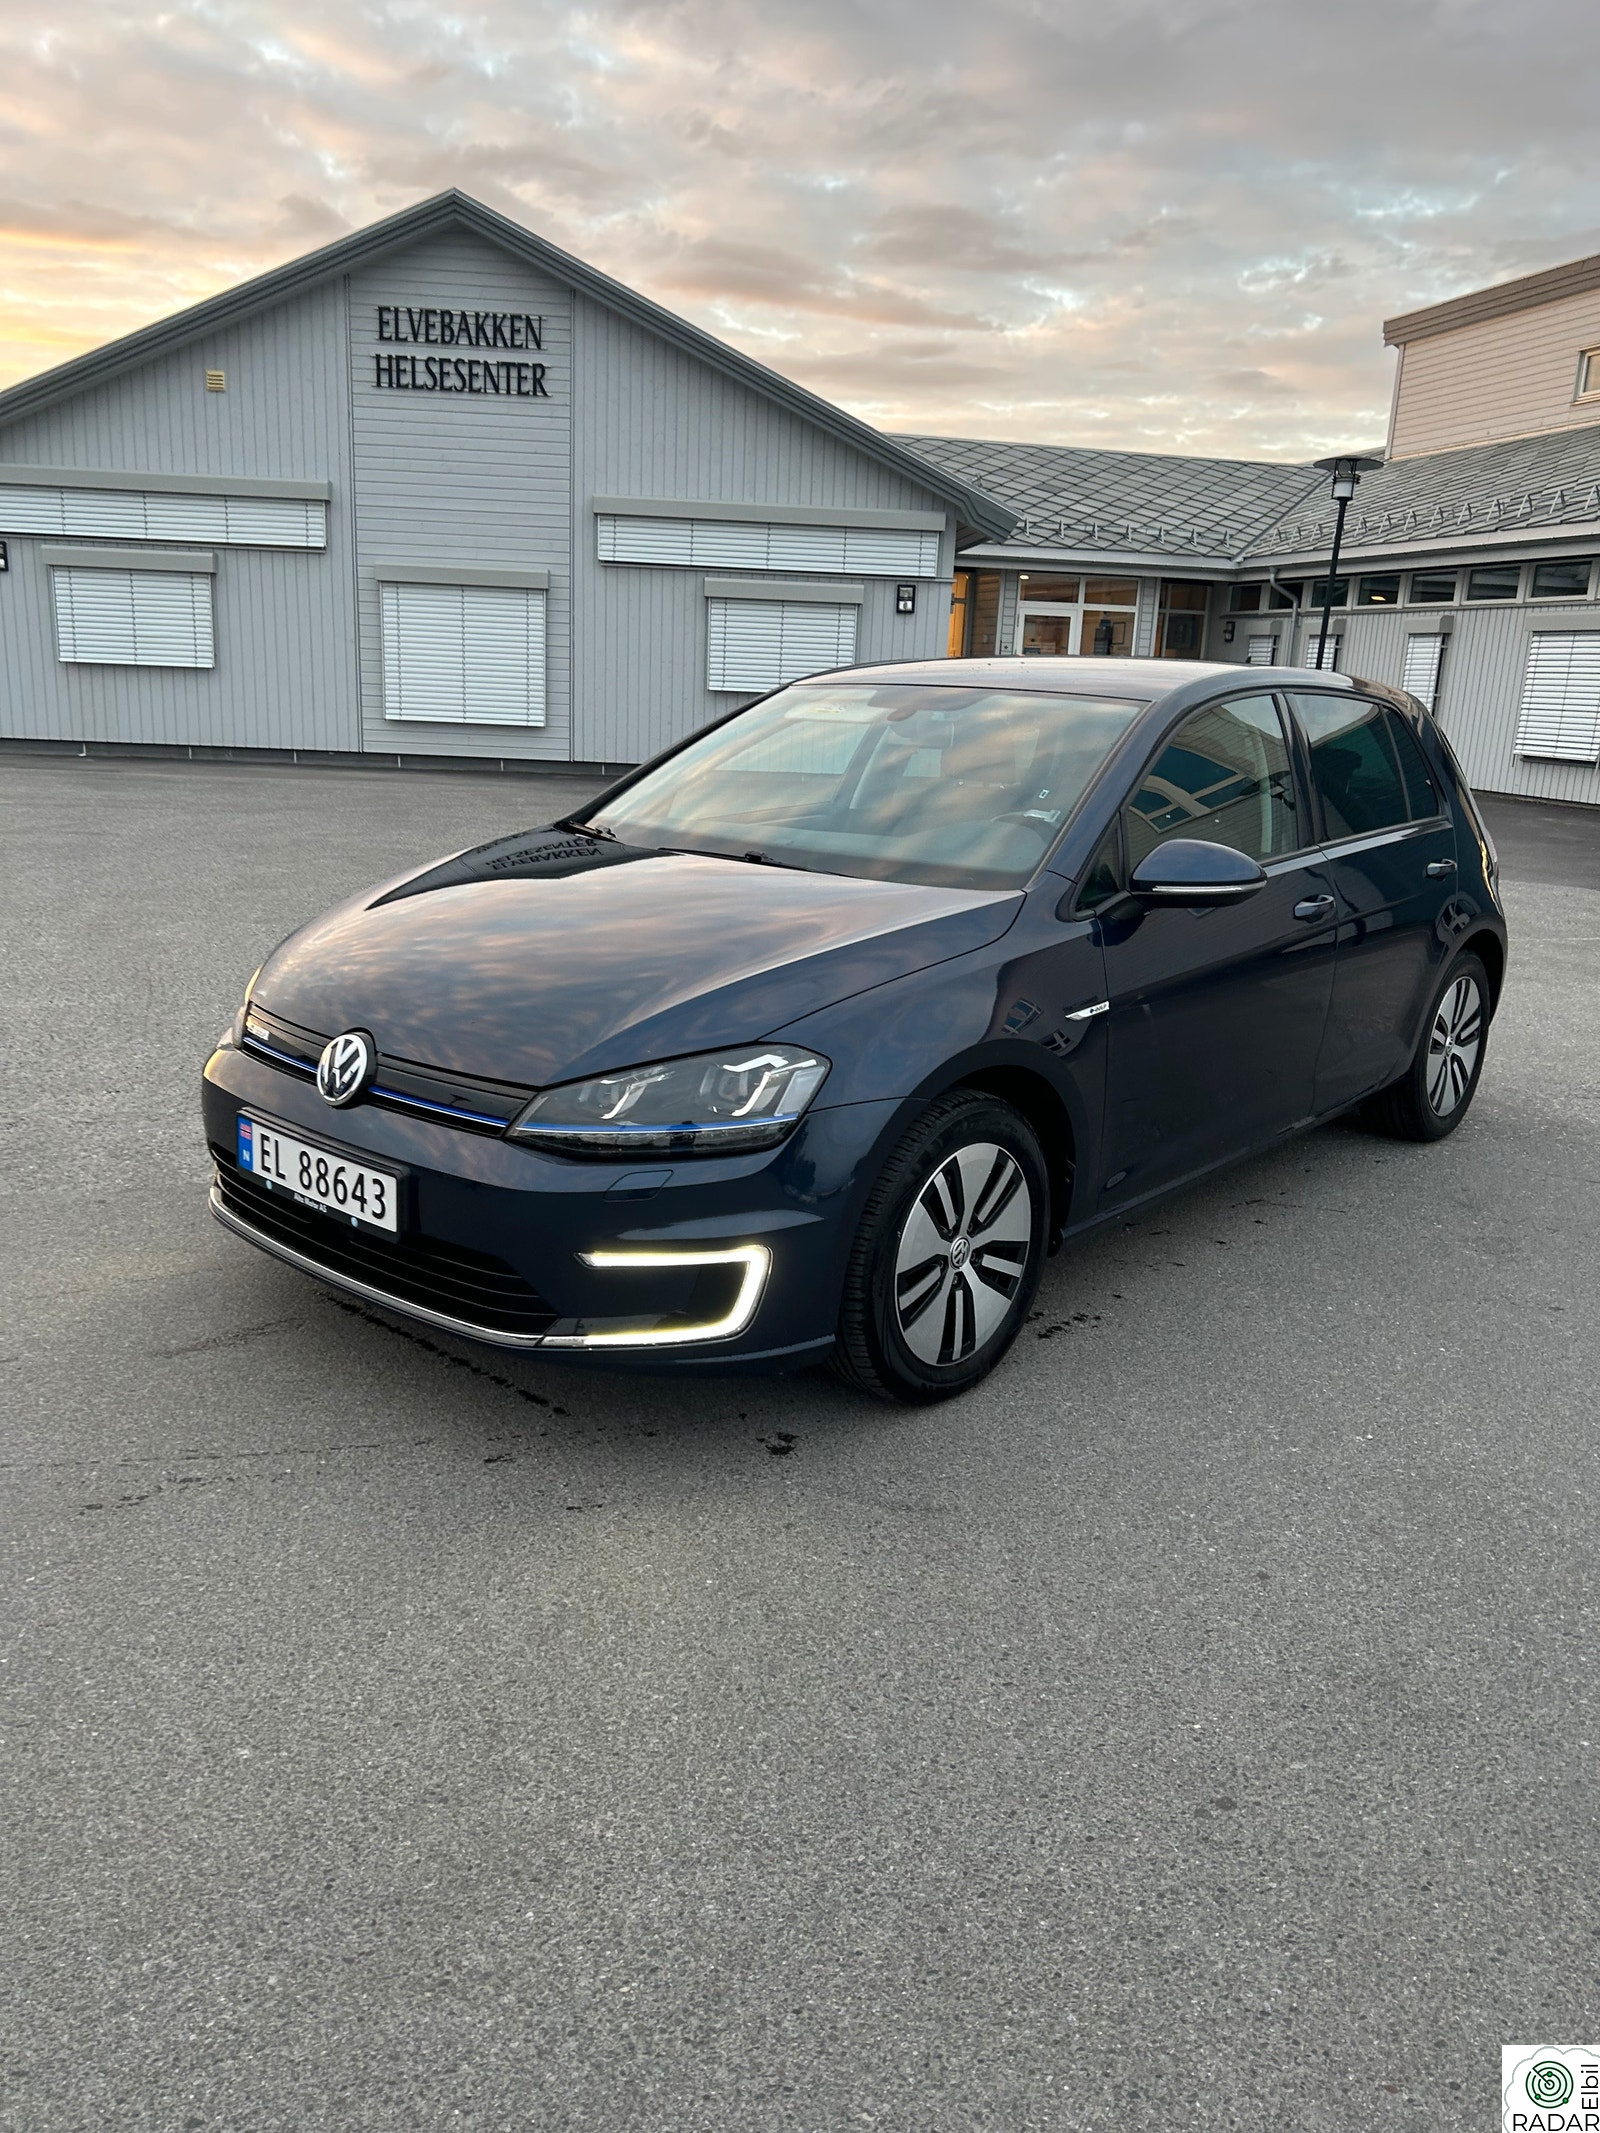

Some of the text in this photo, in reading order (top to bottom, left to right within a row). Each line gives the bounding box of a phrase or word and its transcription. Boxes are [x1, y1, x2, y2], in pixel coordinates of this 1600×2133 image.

[377, 306, 543, 350] ELVEBAKKEN
[375, 353, 549, 397] HELSESENTER
[242, 1149, 250, 1162] N
[260, 1133, 386, 1219] EL 88643
